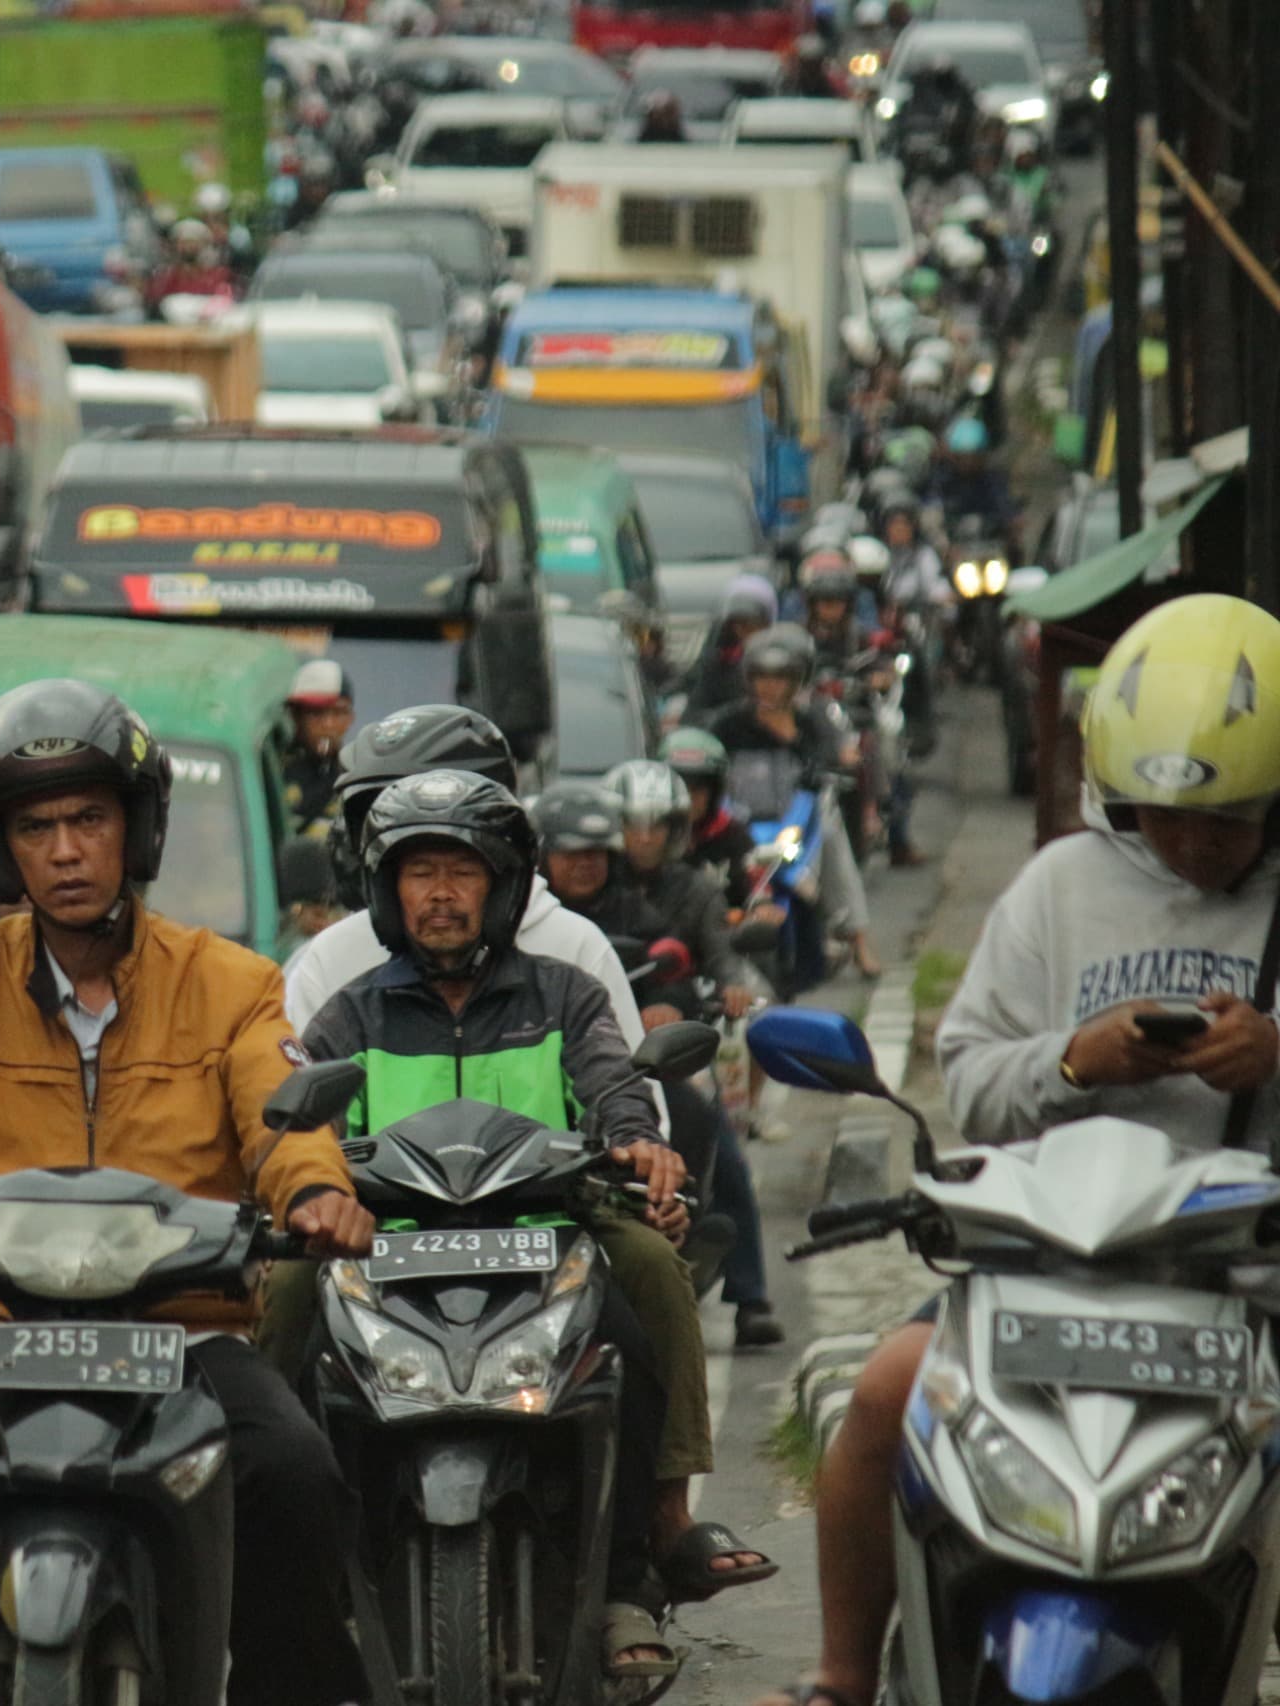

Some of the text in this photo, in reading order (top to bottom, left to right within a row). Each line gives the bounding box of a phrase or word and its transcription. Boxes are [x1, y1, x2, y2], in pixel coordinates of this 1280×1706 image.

[79, 502, 441, 547] Bandung
[373, 1232, 550, 1257] D 4243 VBB
[12, 1328, 99, 1357] 2355
[131, 1330, 179, 1360] UW
[998, 1314, 1022, 1344] D
[1058, 1319, 1159, 1354] 3543
